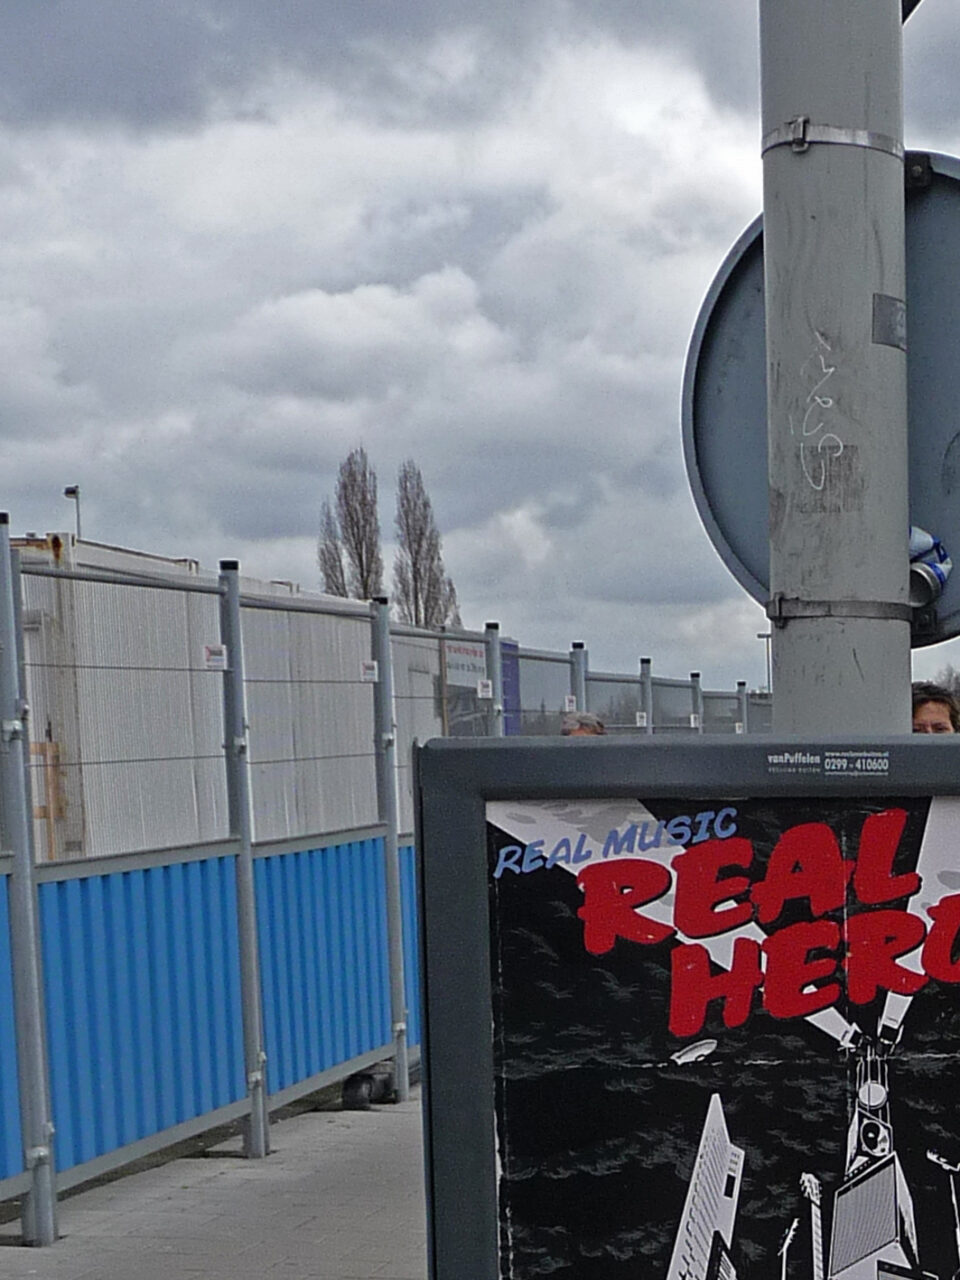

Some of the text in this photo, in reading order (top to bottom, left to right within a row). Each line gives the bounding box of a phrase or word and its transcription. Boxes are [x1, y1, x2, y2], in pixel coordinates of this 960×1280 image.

[824, 758, 847, 770] 0299
[855, 758, 889, 770] 410600
[494, 807, 738, 878] REAL MUSIC
[577, 809, 920, 954] REAL
